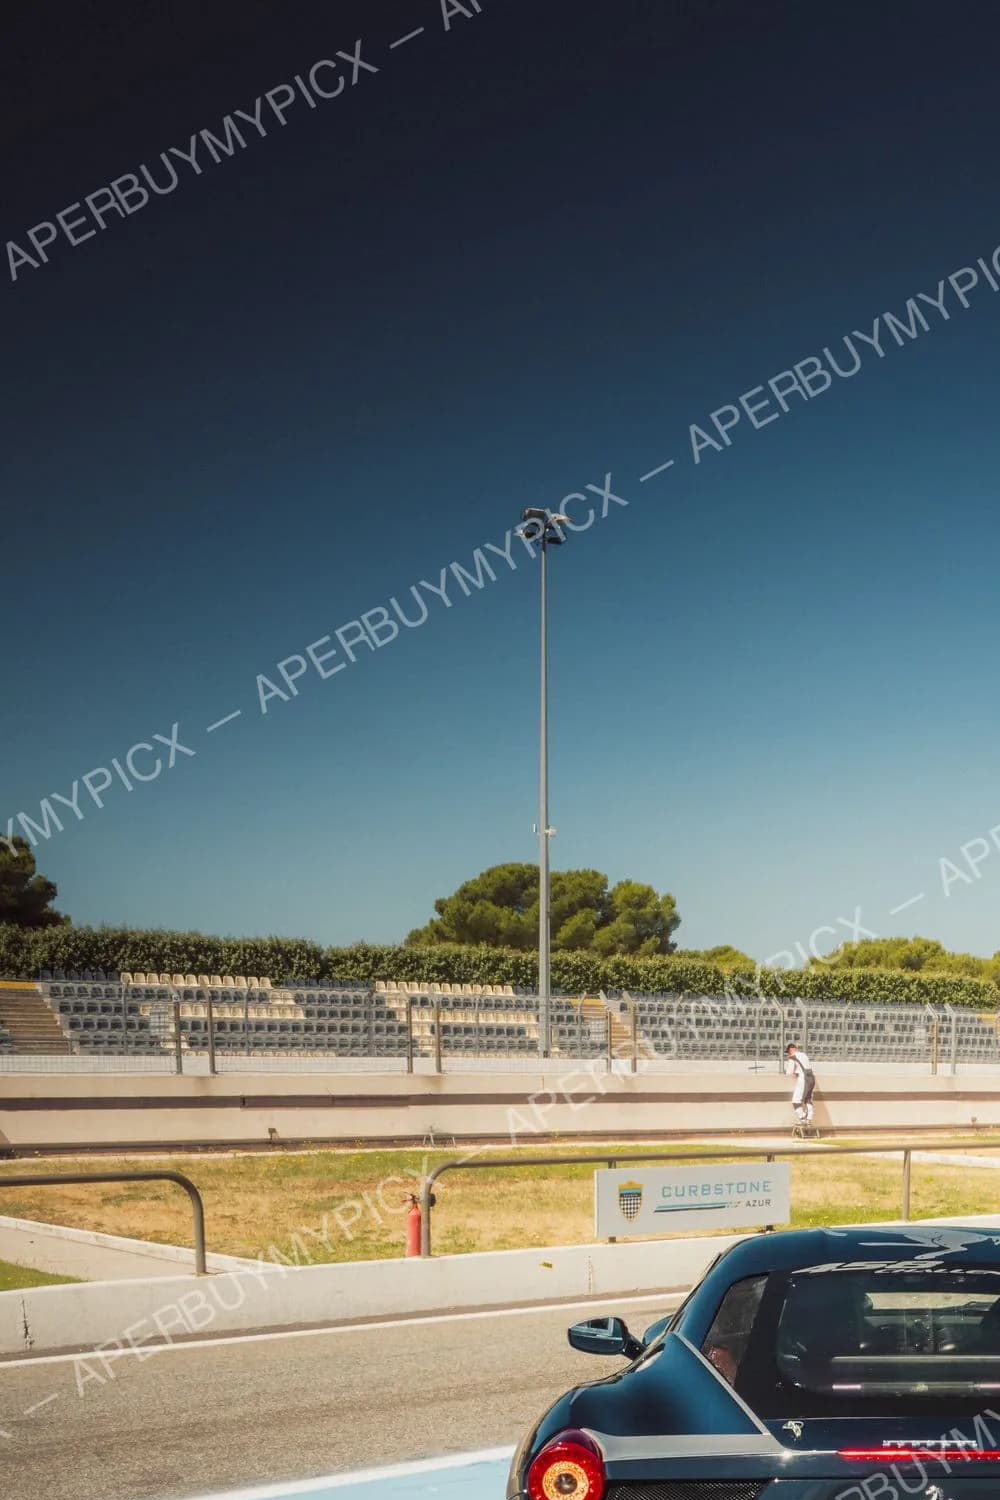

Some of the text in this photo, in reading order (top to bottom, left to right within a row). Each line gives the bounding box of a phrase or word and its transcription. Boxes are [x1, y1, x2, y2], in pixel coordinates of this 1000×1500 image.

[661, 1180, 773, 1198] CURBSTONE
[745, 1199, 772, 1208] AZUR
[791, 1260, 945, 1274] 458
